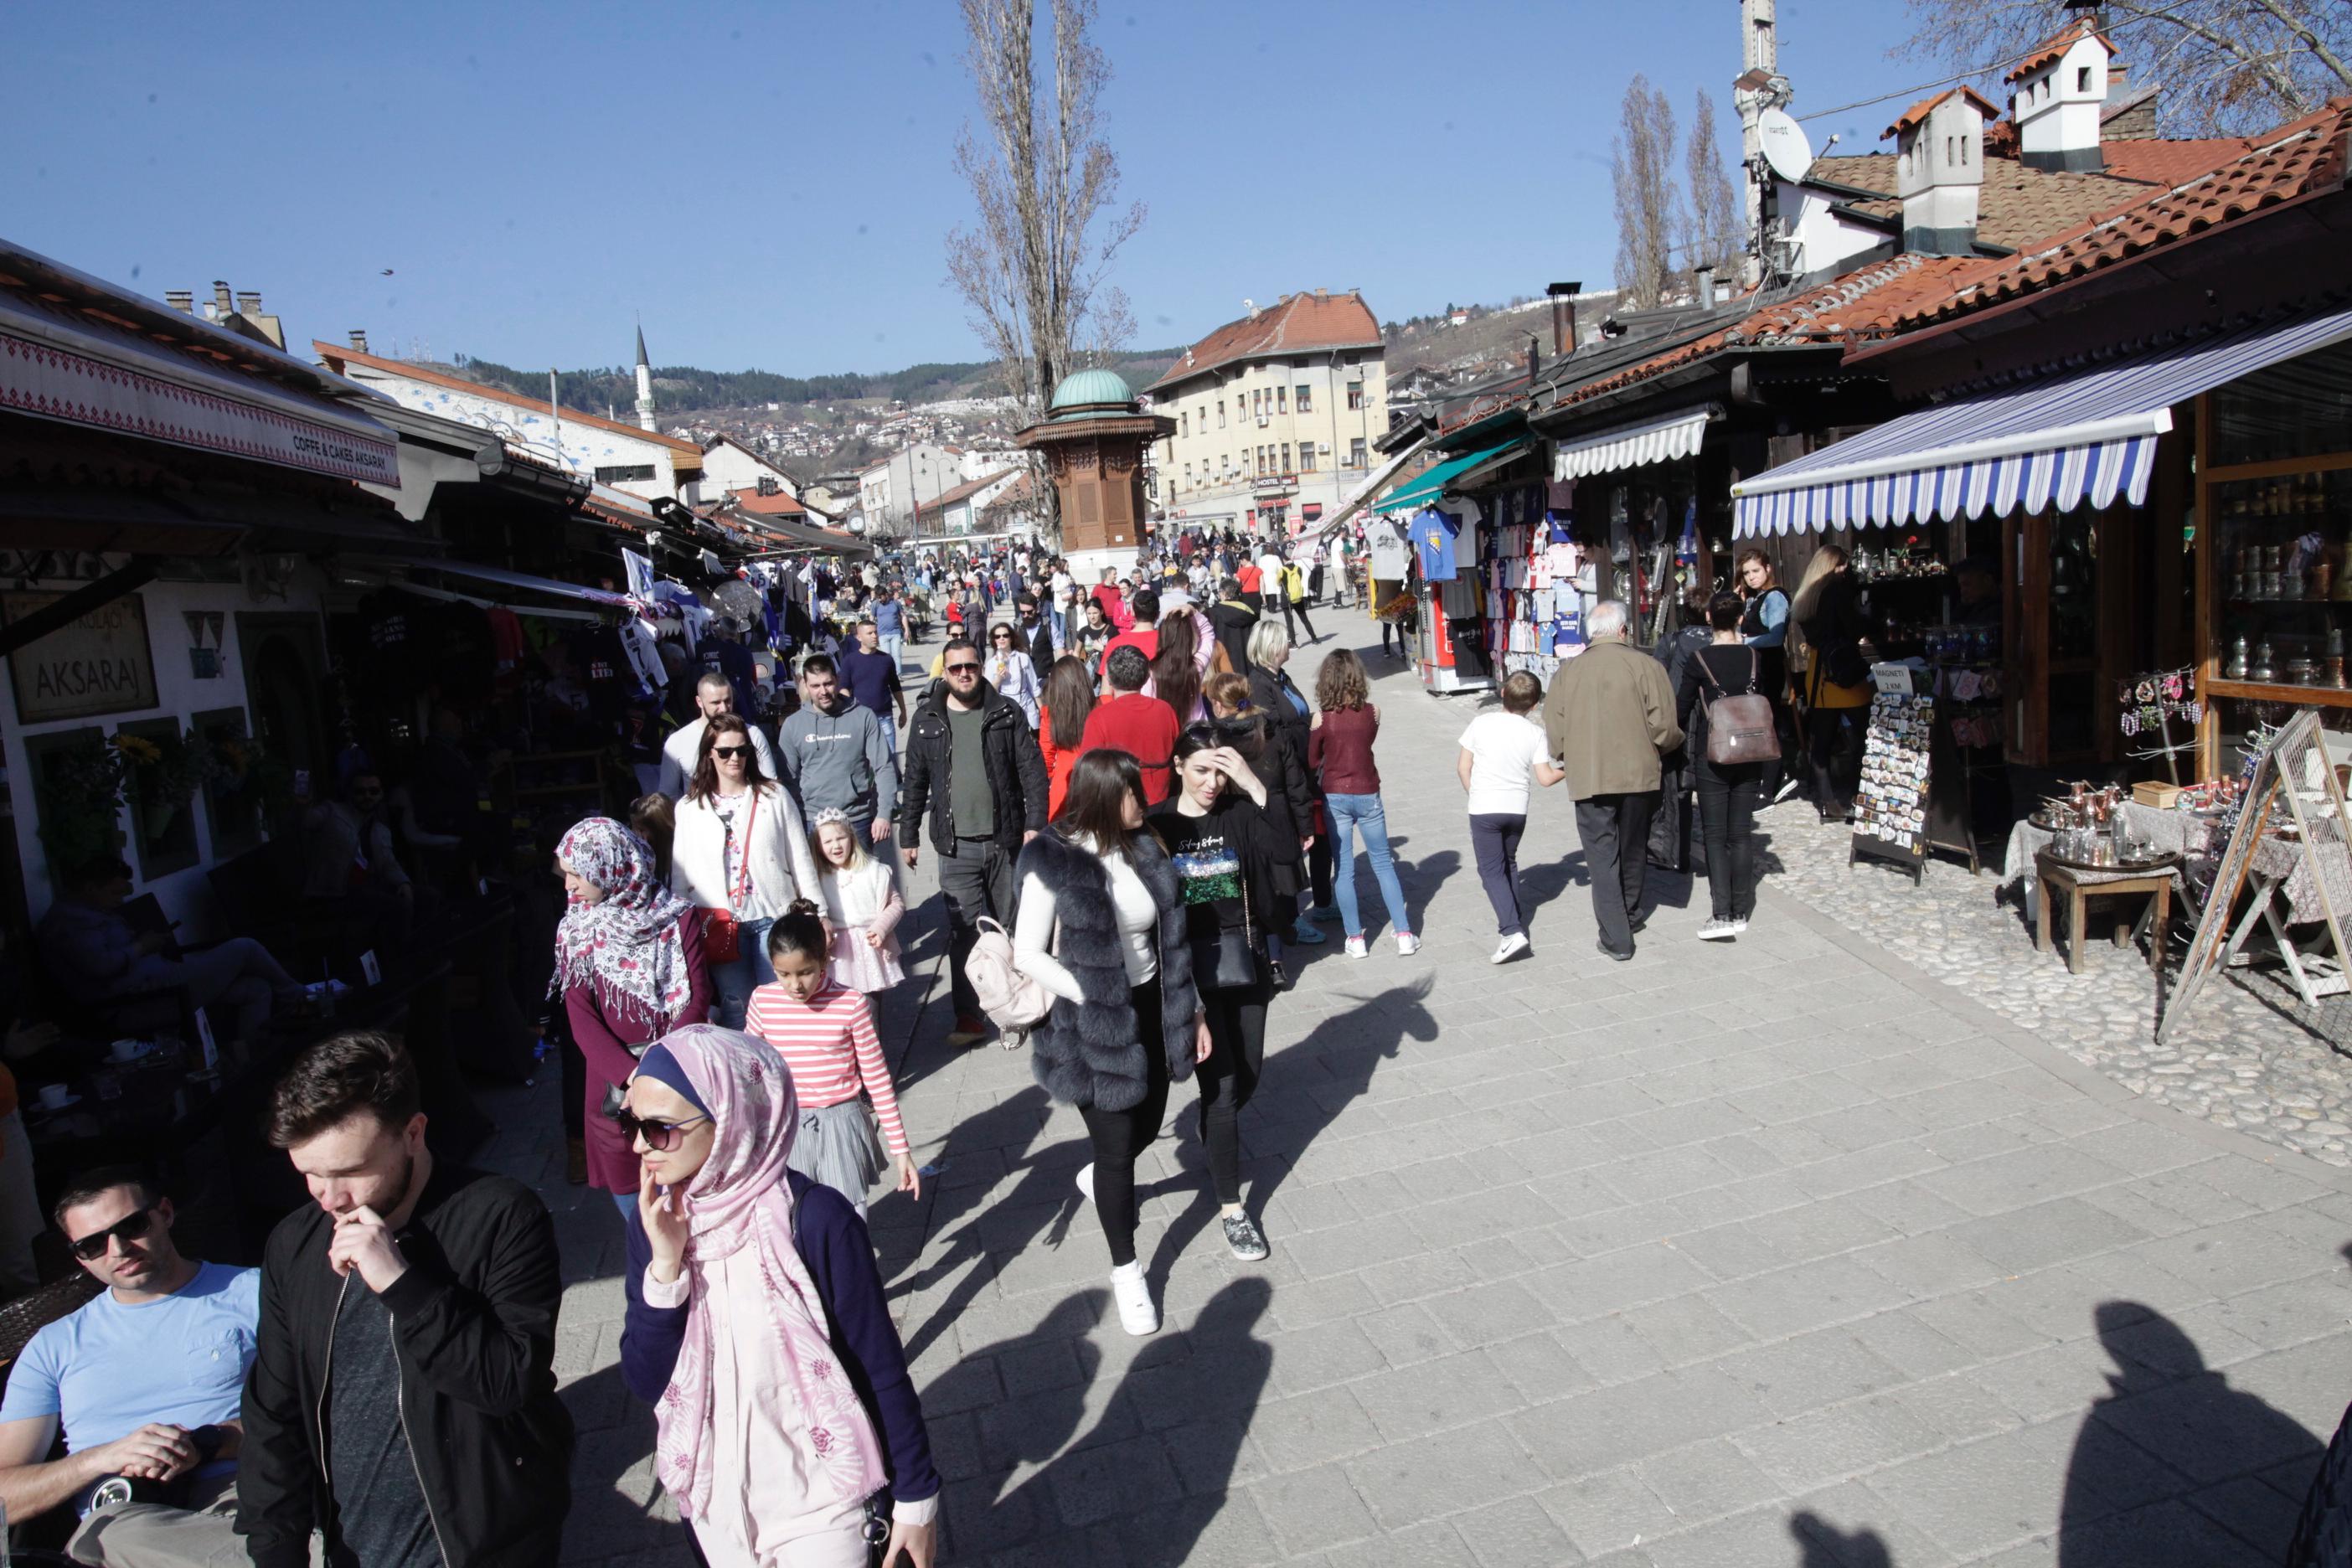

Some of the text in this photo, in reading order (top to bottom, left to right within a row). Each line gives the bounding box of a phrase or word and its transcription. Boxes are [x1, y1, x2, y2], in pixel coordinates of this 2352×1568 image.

[293, 436, 385, 469] COFFE & CAKES AKSARAY
[632, 647, 646, 670] 7
[37, 657, 139, 699] AKSARAJ
